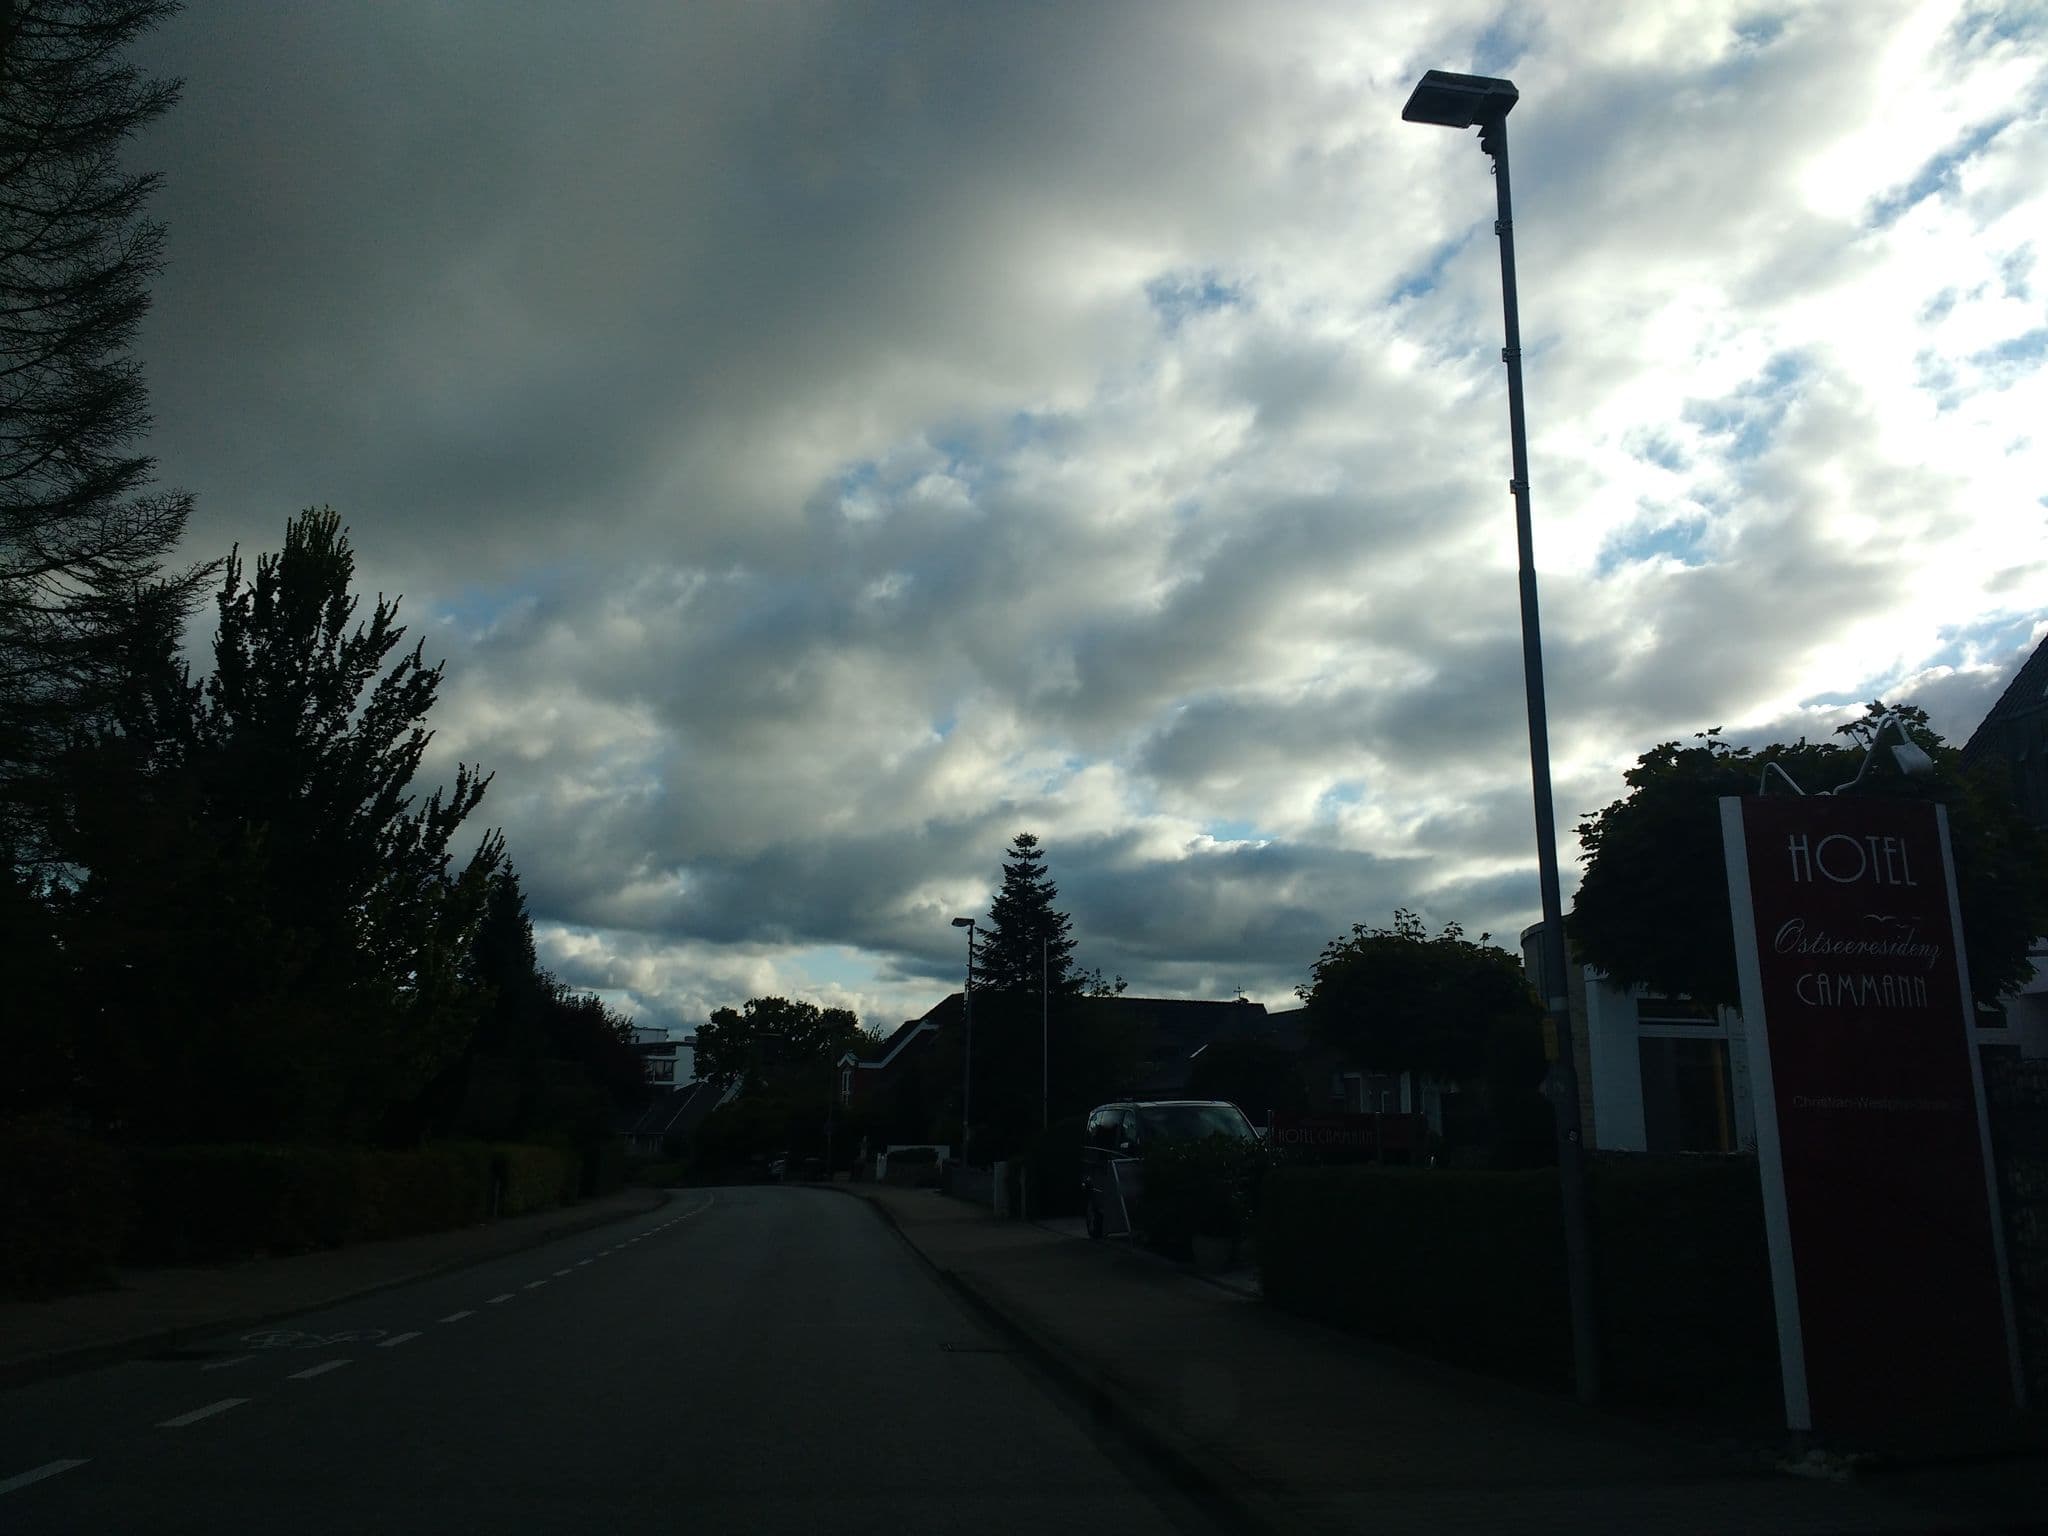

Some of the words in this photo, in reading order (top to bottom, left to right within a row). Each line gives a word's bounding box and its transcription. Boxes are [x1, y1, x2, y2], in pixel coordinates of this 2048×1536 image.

[1788, 834, 1918, 886] HOTEL
[1775, 917, 1941, 969] Ostseeresidenz
[1796, 973, 1928, 1008] CAMMANN
